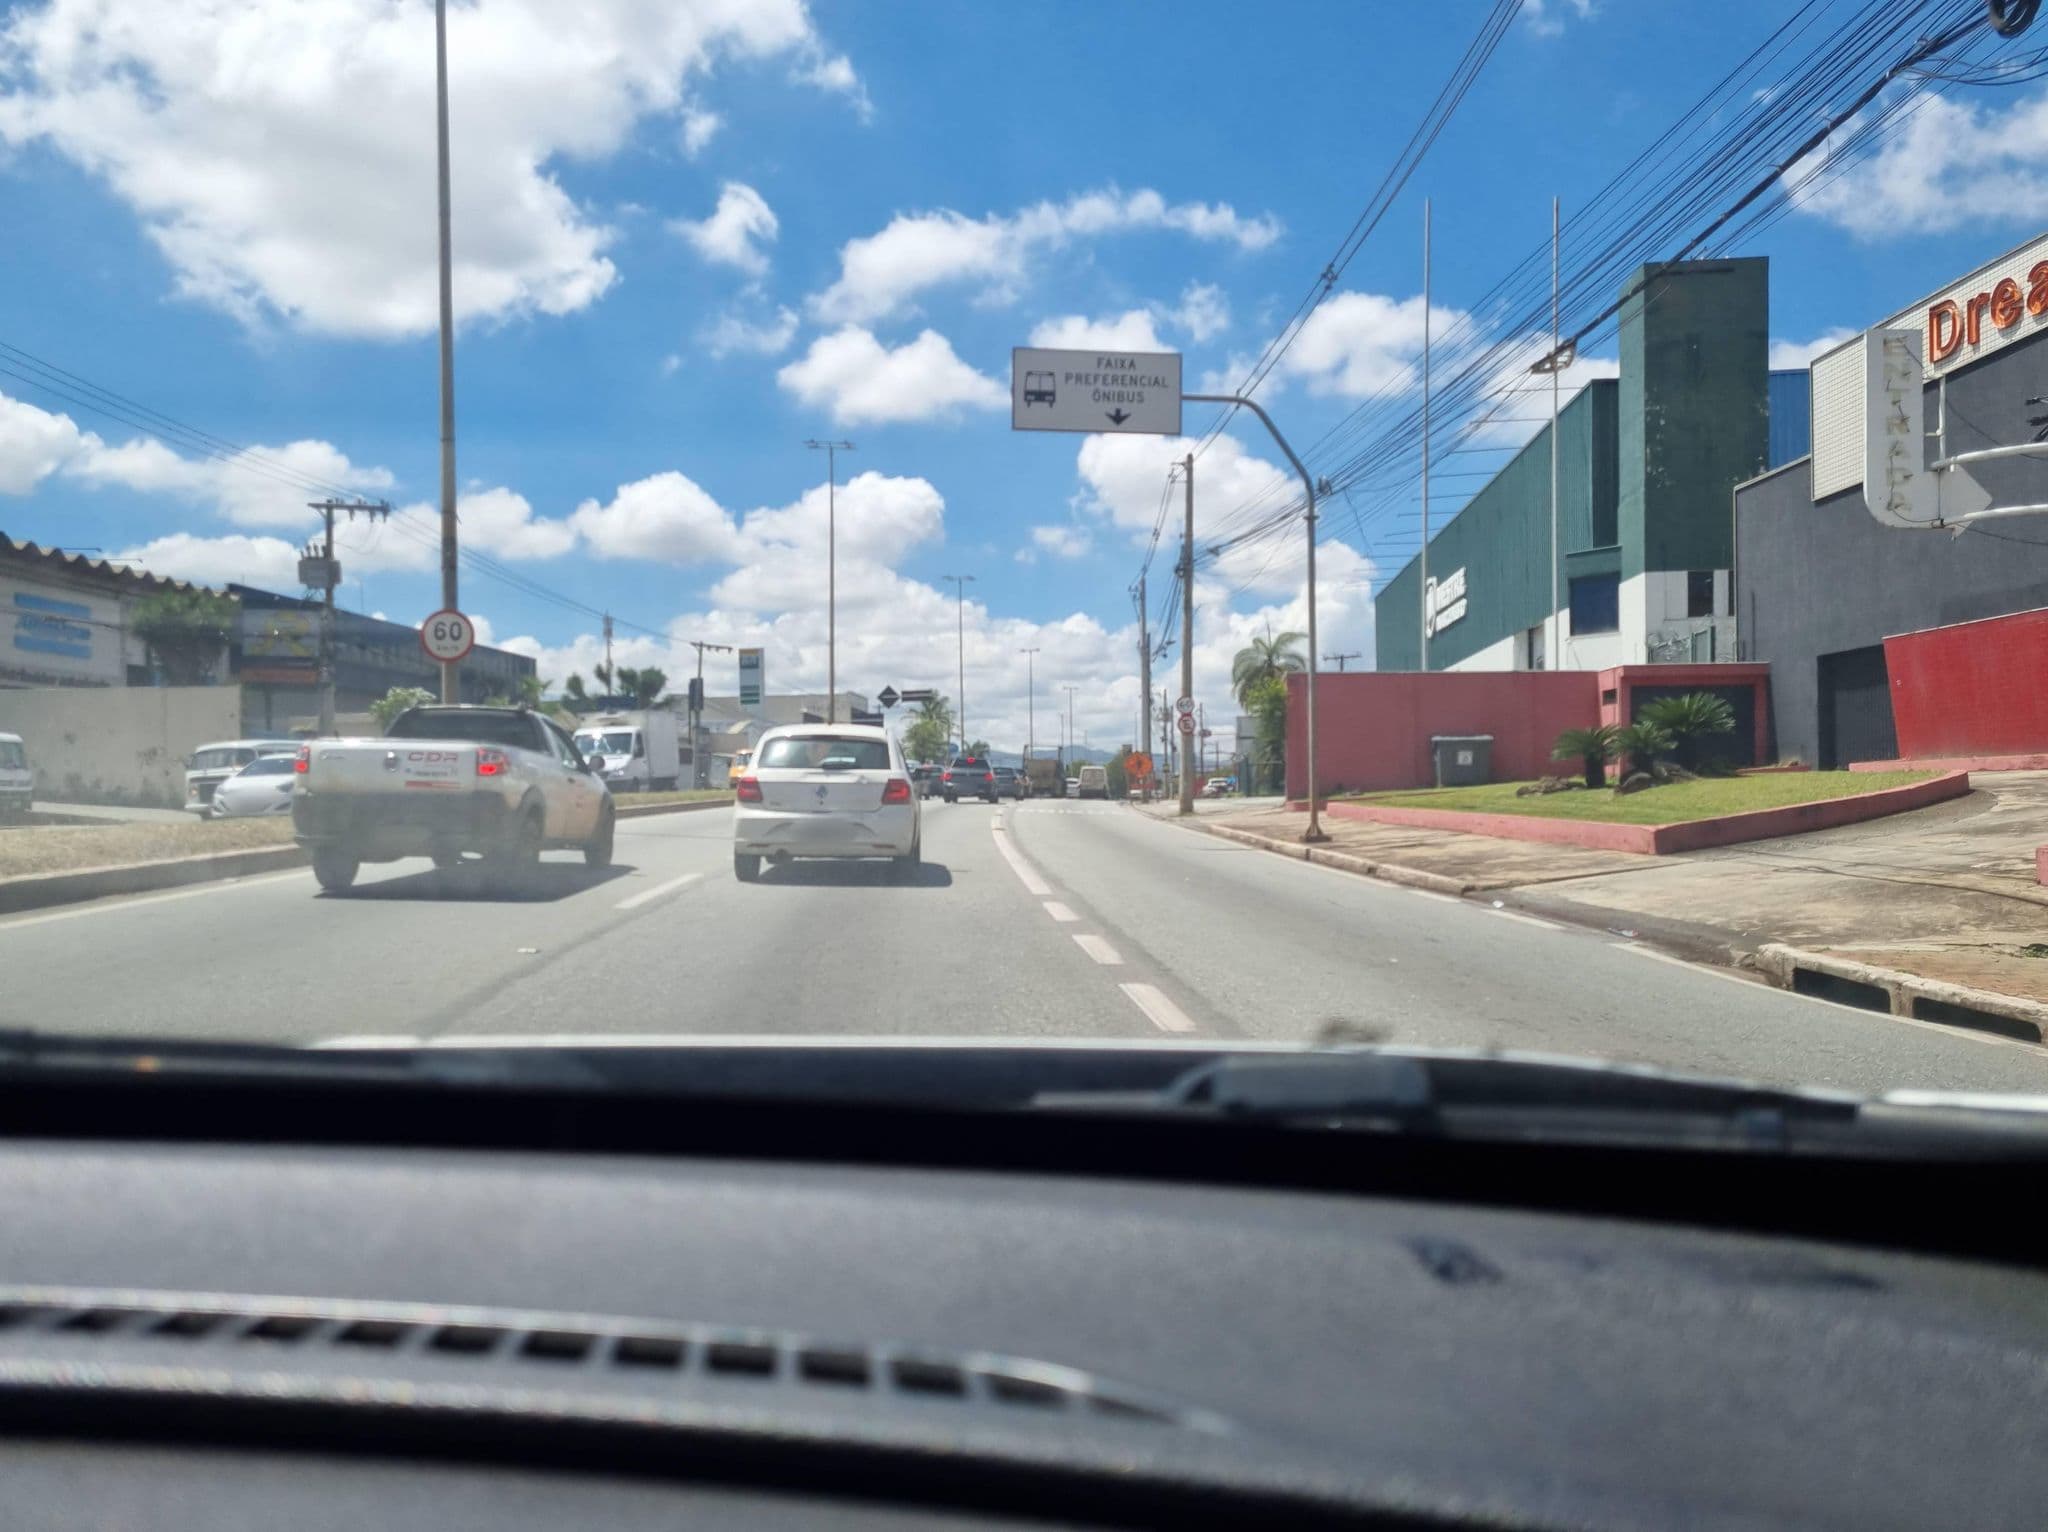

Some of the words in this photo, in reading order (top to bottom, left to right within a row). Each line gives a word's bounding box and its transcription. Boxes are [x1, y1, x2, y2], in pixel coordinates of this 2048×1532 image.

[1097, 357, 1136, 369] FAIXA
[1065, 373, 1168, 387] PREFERENCIAL
[1092, 389, 1144, 403] ÔNIBUS
[434, 621, 462, 641] 60
